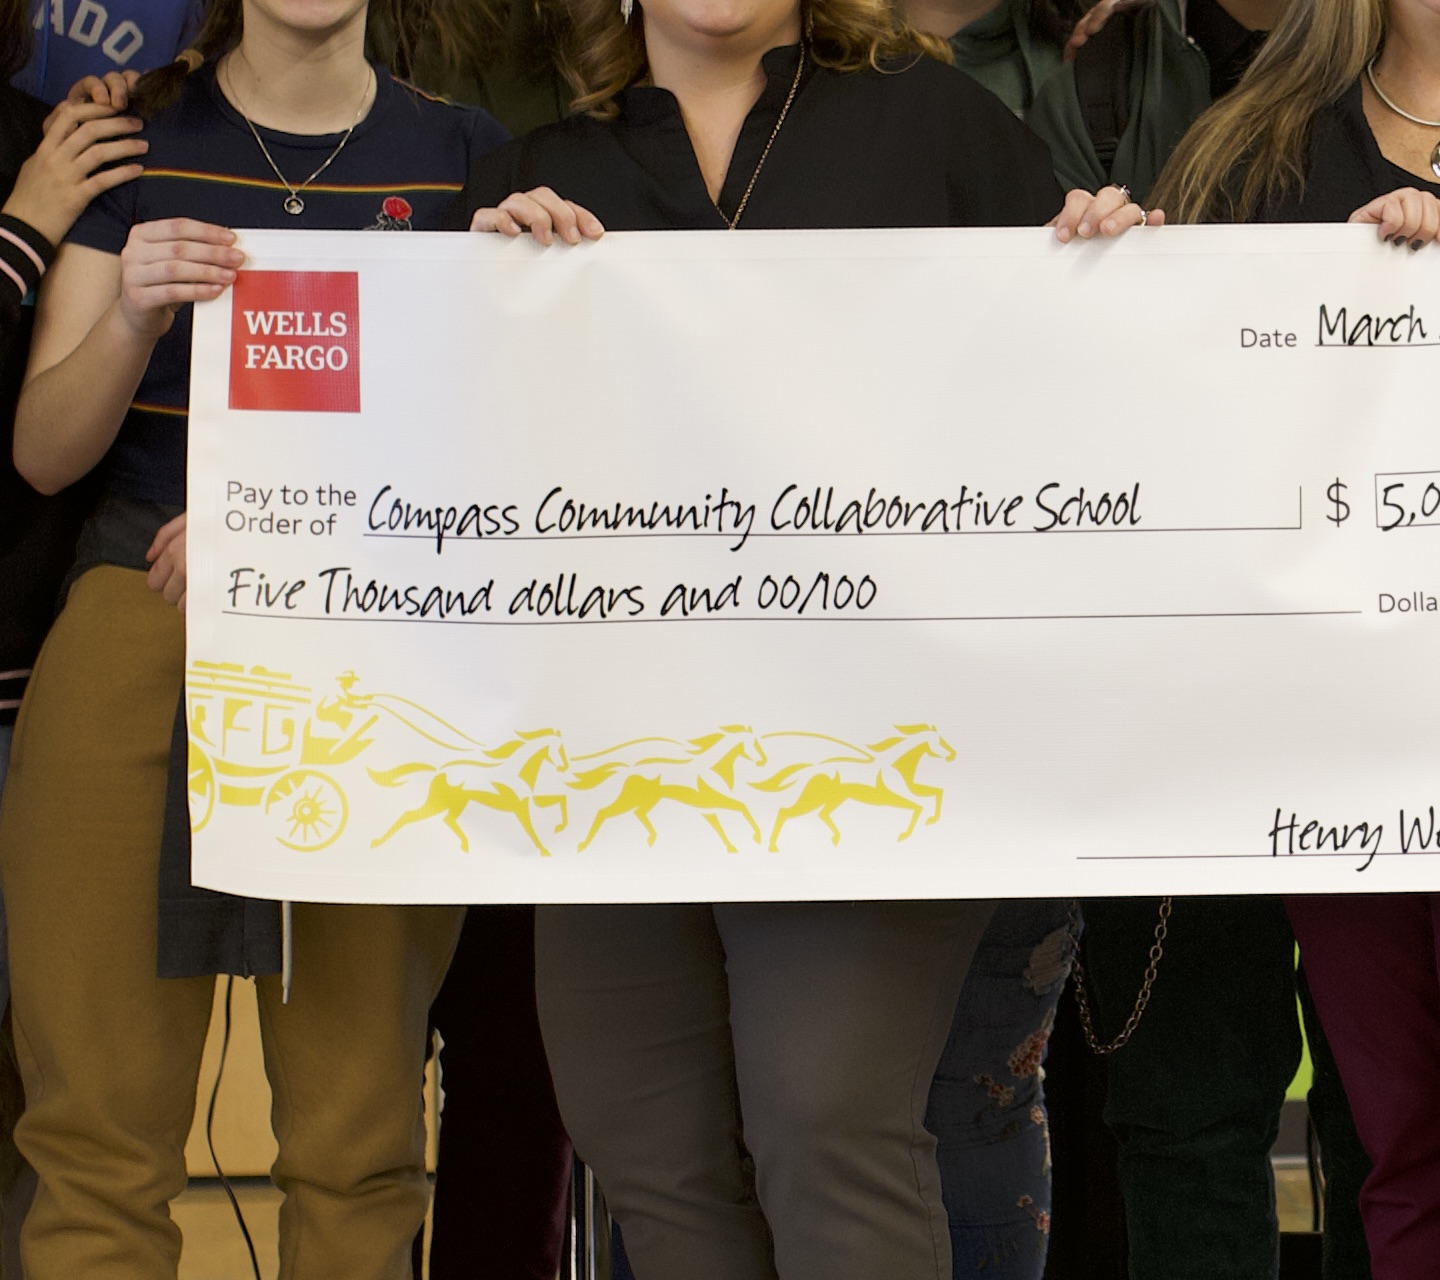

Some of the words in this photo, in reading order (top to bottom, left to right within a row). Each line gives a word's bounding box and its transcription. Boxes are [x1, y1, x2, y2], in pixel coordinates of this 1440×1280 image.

[243, 310, 348, 338] WELLS
[1240, 328, 1297, 349] Date
[1317, 303, 1428, 346] March
[244, 344, 349, 372] FARGO
[226, 481, 274, 508] Pay
[280, 485, 310, 506] to
[315, 483, 357, 507] the
[1326, 477, 1351, 528] $
[225, 510, 302, 535] Order
[309, 513, 338, 536] of
[365, 484, 520, 554] Compass
[534, 486, 756, 553] Community
[769, 483, 1024, 536] Collaborative
[1031, 482, 1142, 534] School
[227, 567, 306, 610] Five
[318, 566, 494, 617] Thousand
[508, 572, 645, 617] dollars
[659, 574, 743, 616] and
[756, 572, 878, 614] 00/100
[1267, 807, 1384, 873] Henry
